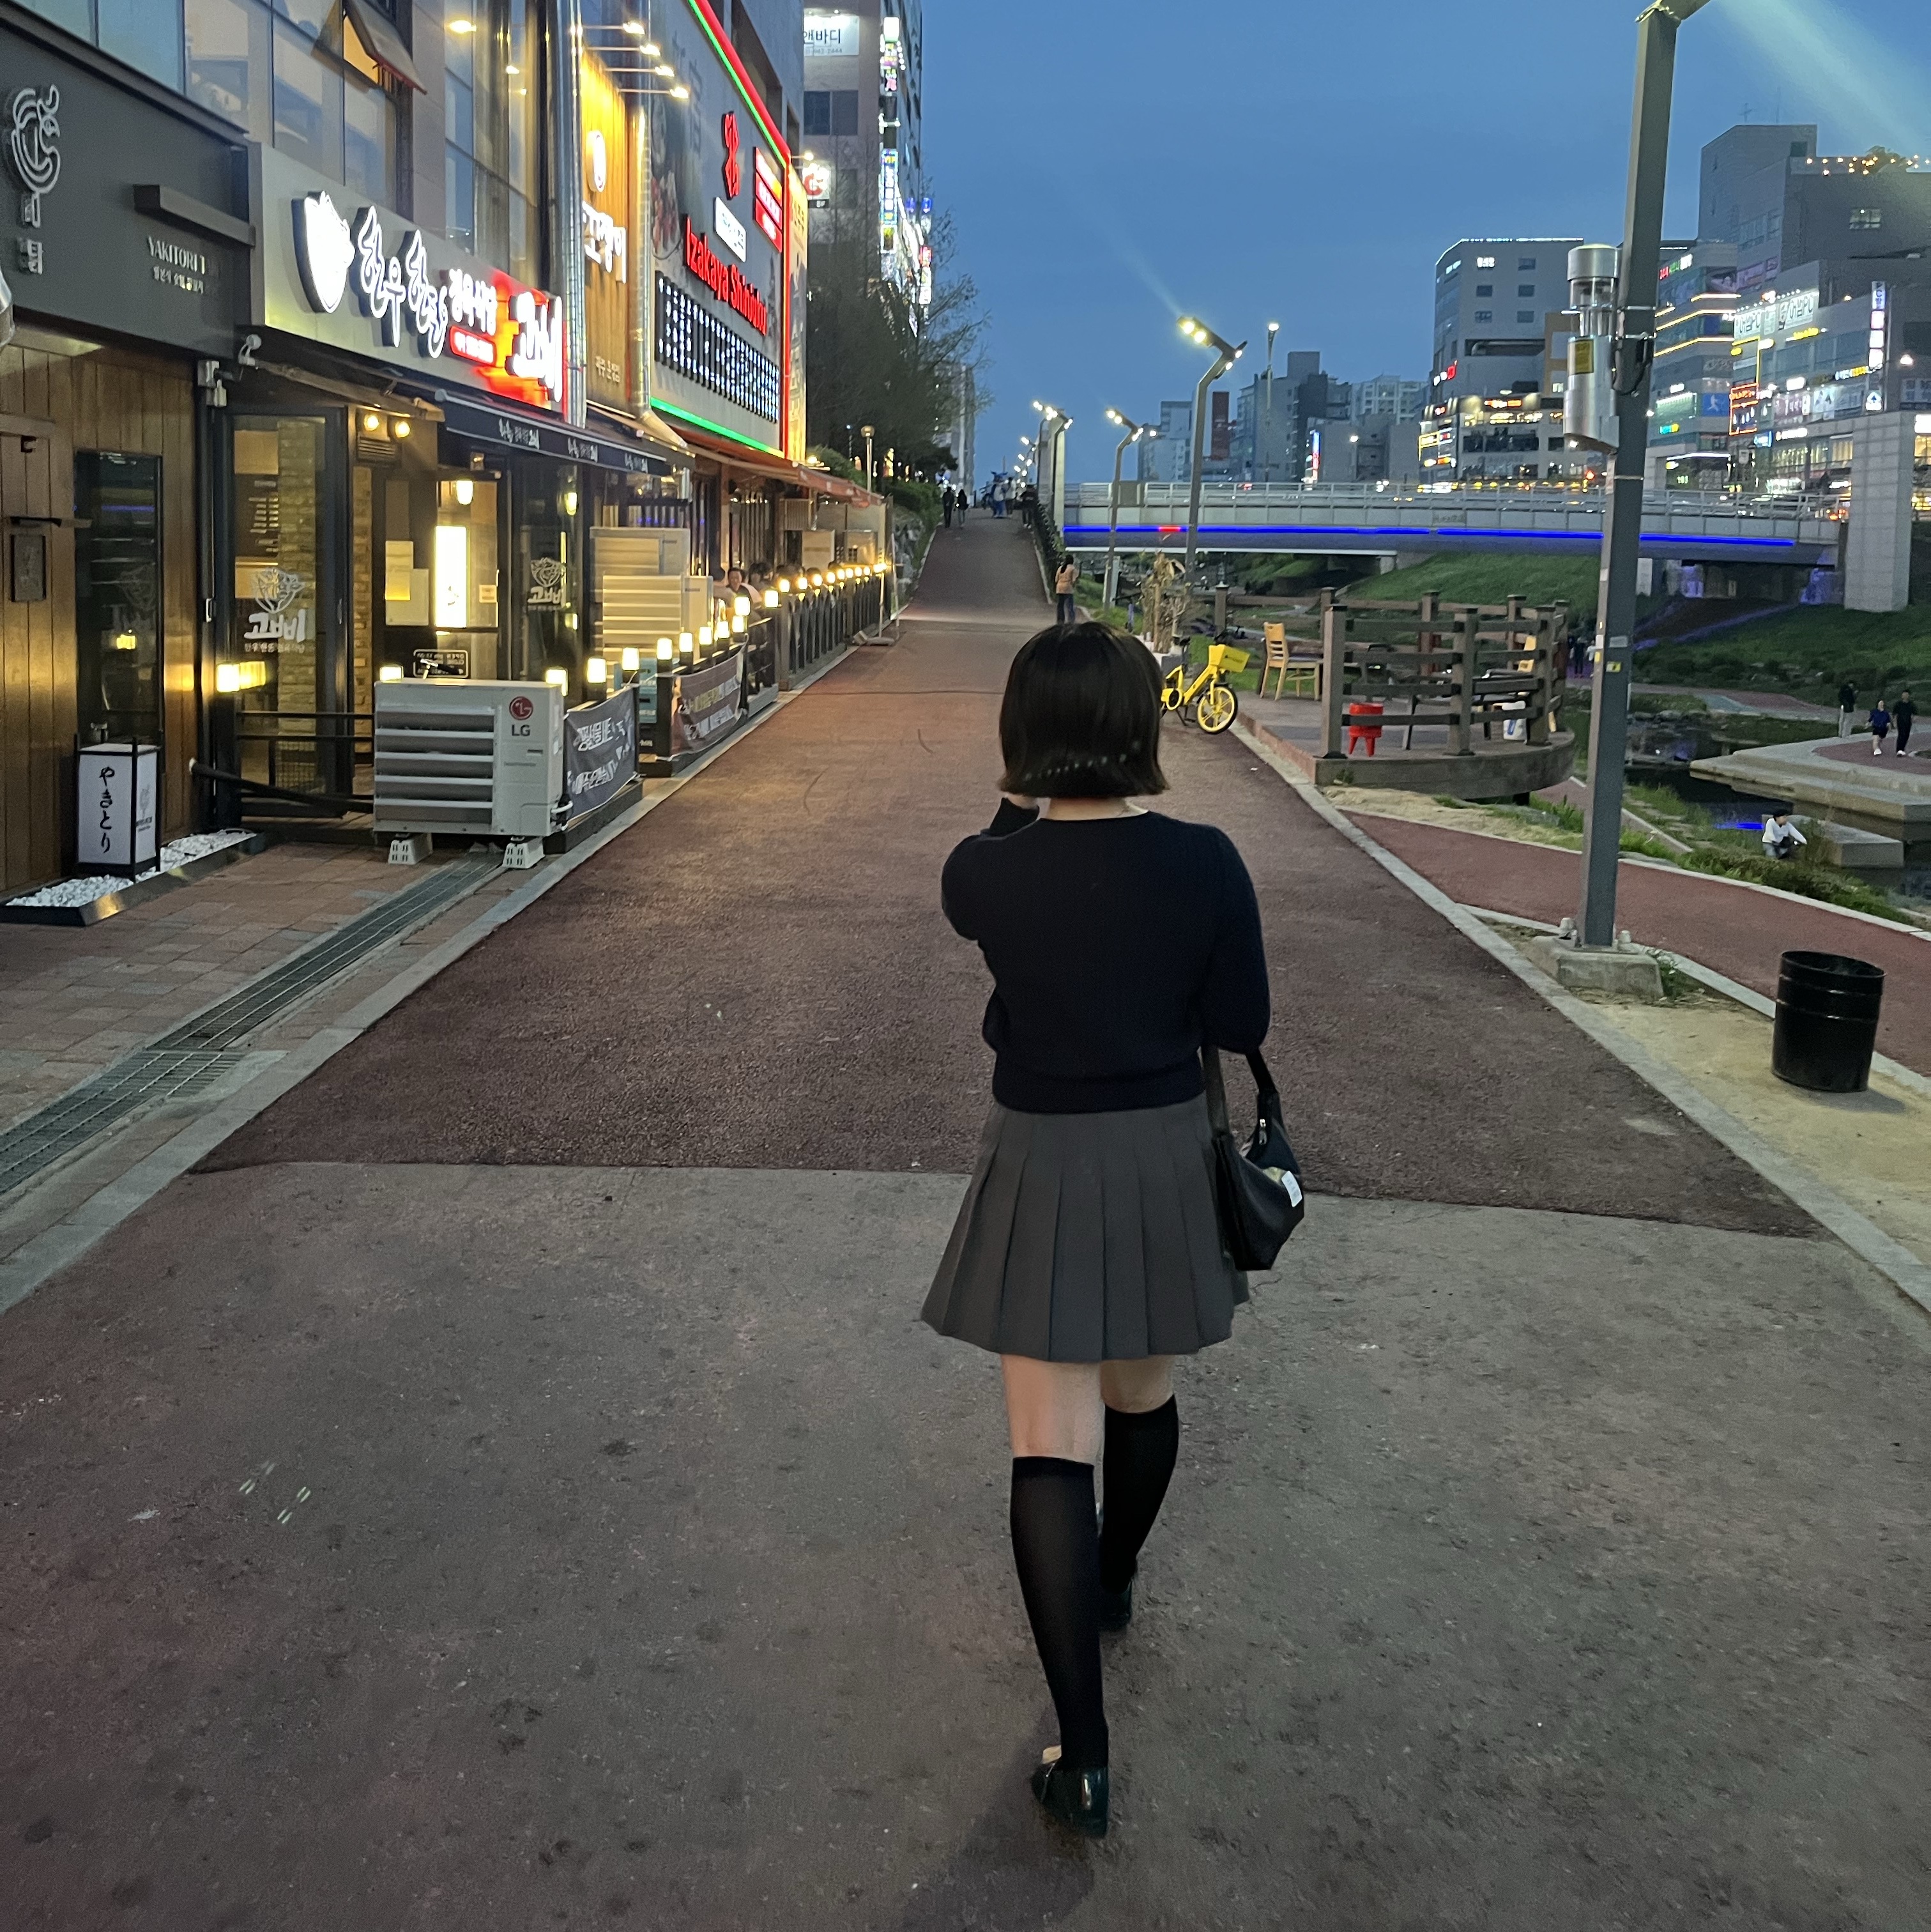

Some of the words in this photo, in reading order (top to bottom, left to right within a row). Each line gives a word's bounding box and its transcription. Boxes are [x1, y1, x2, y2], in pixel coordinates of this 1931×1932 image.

[148, 235, 197, 273] YAKITORI
[686, 216, 729, 302] Izakaya
[730, 264, 767, 336] Shinjuku
[512, 724, 531, 737] LG
[99, 766, 116, 854] やきとり
